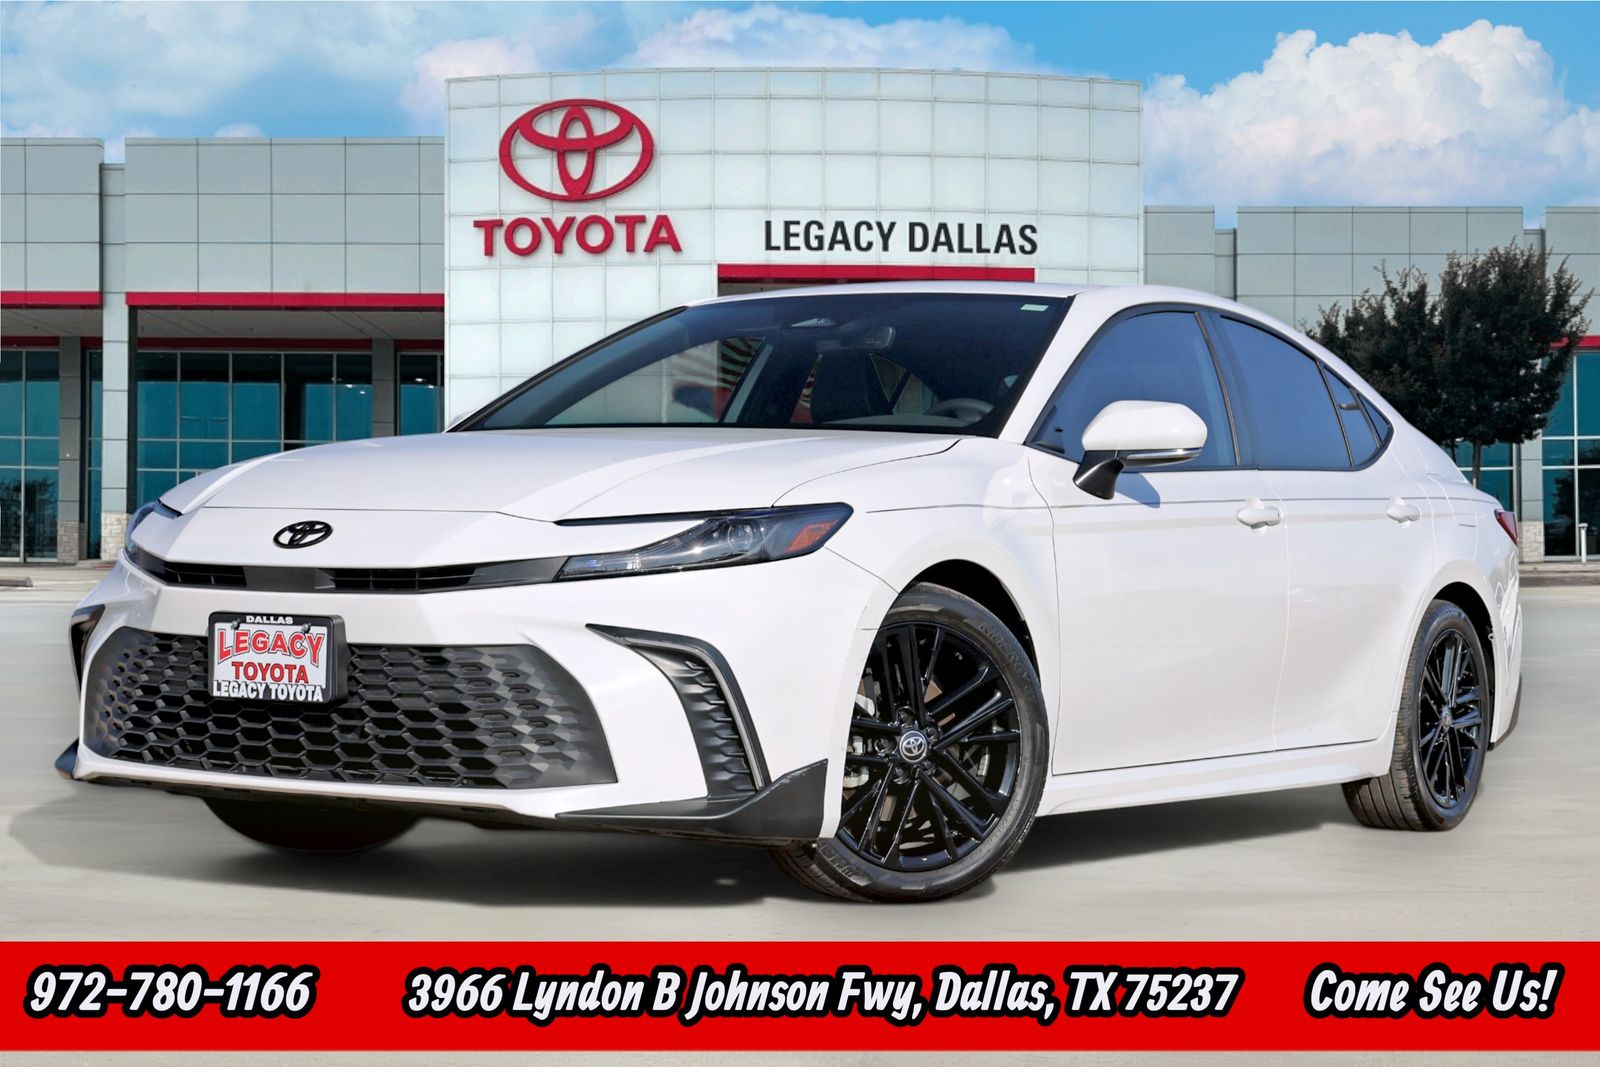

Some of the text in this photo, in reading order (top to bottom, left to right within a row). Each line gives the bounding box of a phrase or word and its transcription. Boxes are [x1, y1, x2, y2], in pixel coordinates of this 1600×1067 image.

[474, 214, 682, 257] TOYOTA
[765, 220, 1039, 256] LEGACY DALLAS
[246, 615, 294, 625] DALLAS
[217, 628, 326, 668] LEGACY
[231, 661, 309, 684] TOYOTA
[213, 680, 323, 702] LEGACY TOYOTA
